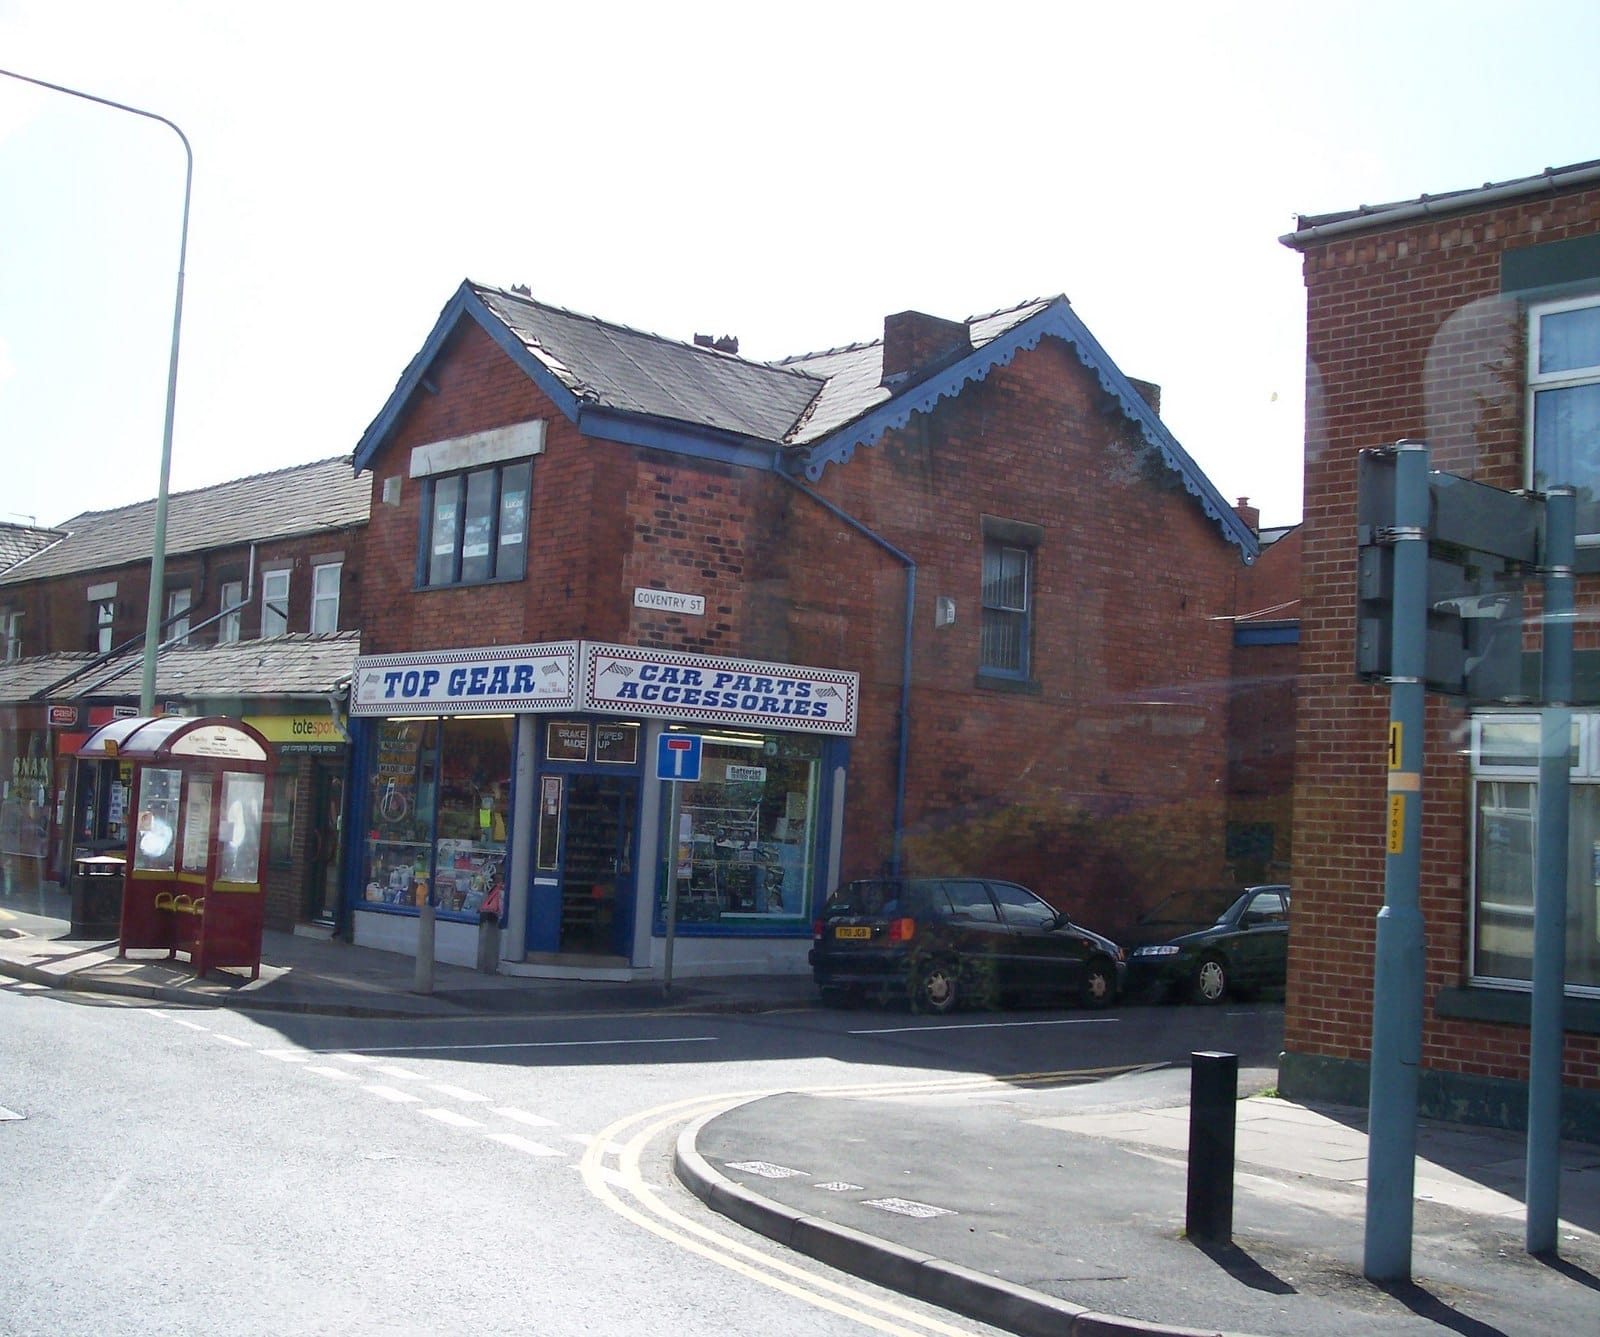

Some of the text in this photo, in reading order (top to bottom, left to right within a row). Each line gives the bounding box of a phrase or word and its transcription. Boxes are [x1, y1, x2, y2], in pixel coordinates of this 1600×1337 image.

[638, 592, 702, 610] COVENTRY ST
[384, 664, 536, 698] TOP GEAR
[638, 665, 812, 699] CAR PARTS
[616, 681, 828, 718] ACCESSORIES
[559, 729, 624, 741] BRAKE PIPES
[598, 740, 610, 749] UP
